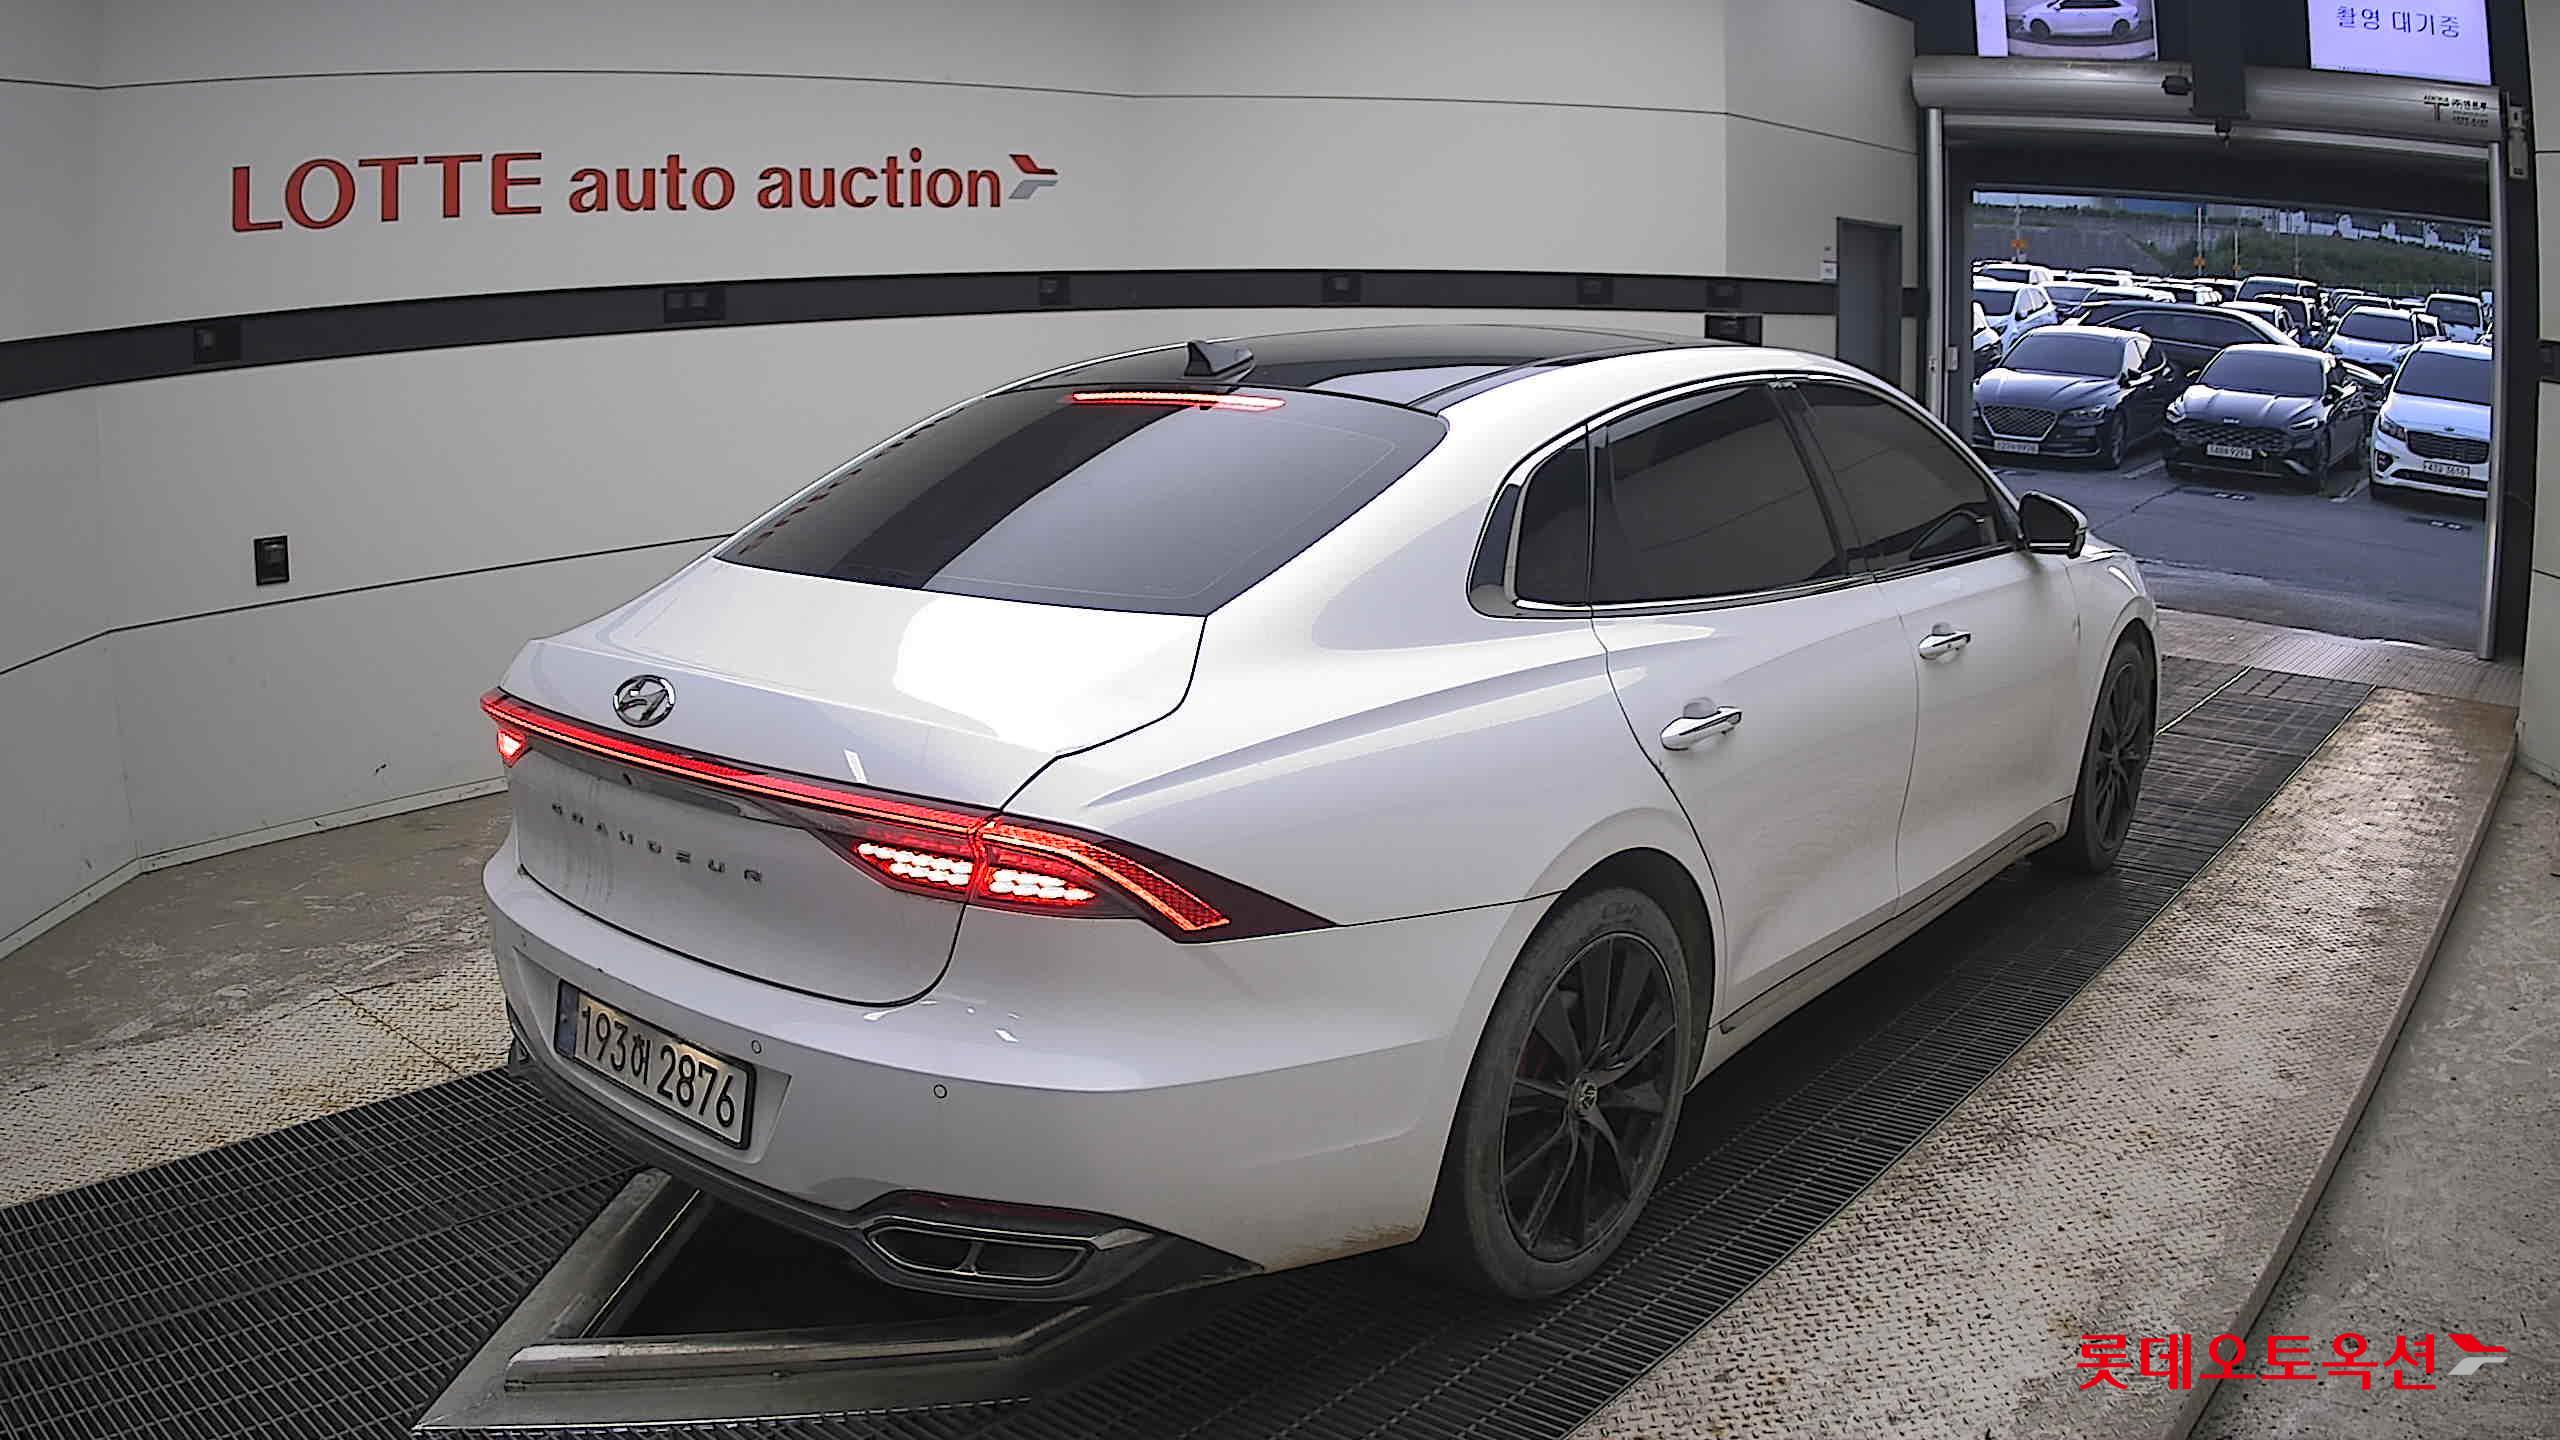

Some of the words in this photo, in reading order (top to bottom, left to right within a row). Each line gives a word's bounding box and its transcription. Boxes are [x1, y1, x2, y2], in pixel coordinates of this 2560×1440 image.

[2337, 5, 2381, 31] 촬영
[2391, 10, 2461, 39] 대기중
[231, 151, 543, 233] LOTTE
[567, 153, 737, 213] auto
[757, 146, 1003, 210] auction
[551, 803, 763, 883] GRANDEUR
[656, 1044, 736, 1128] 2876
